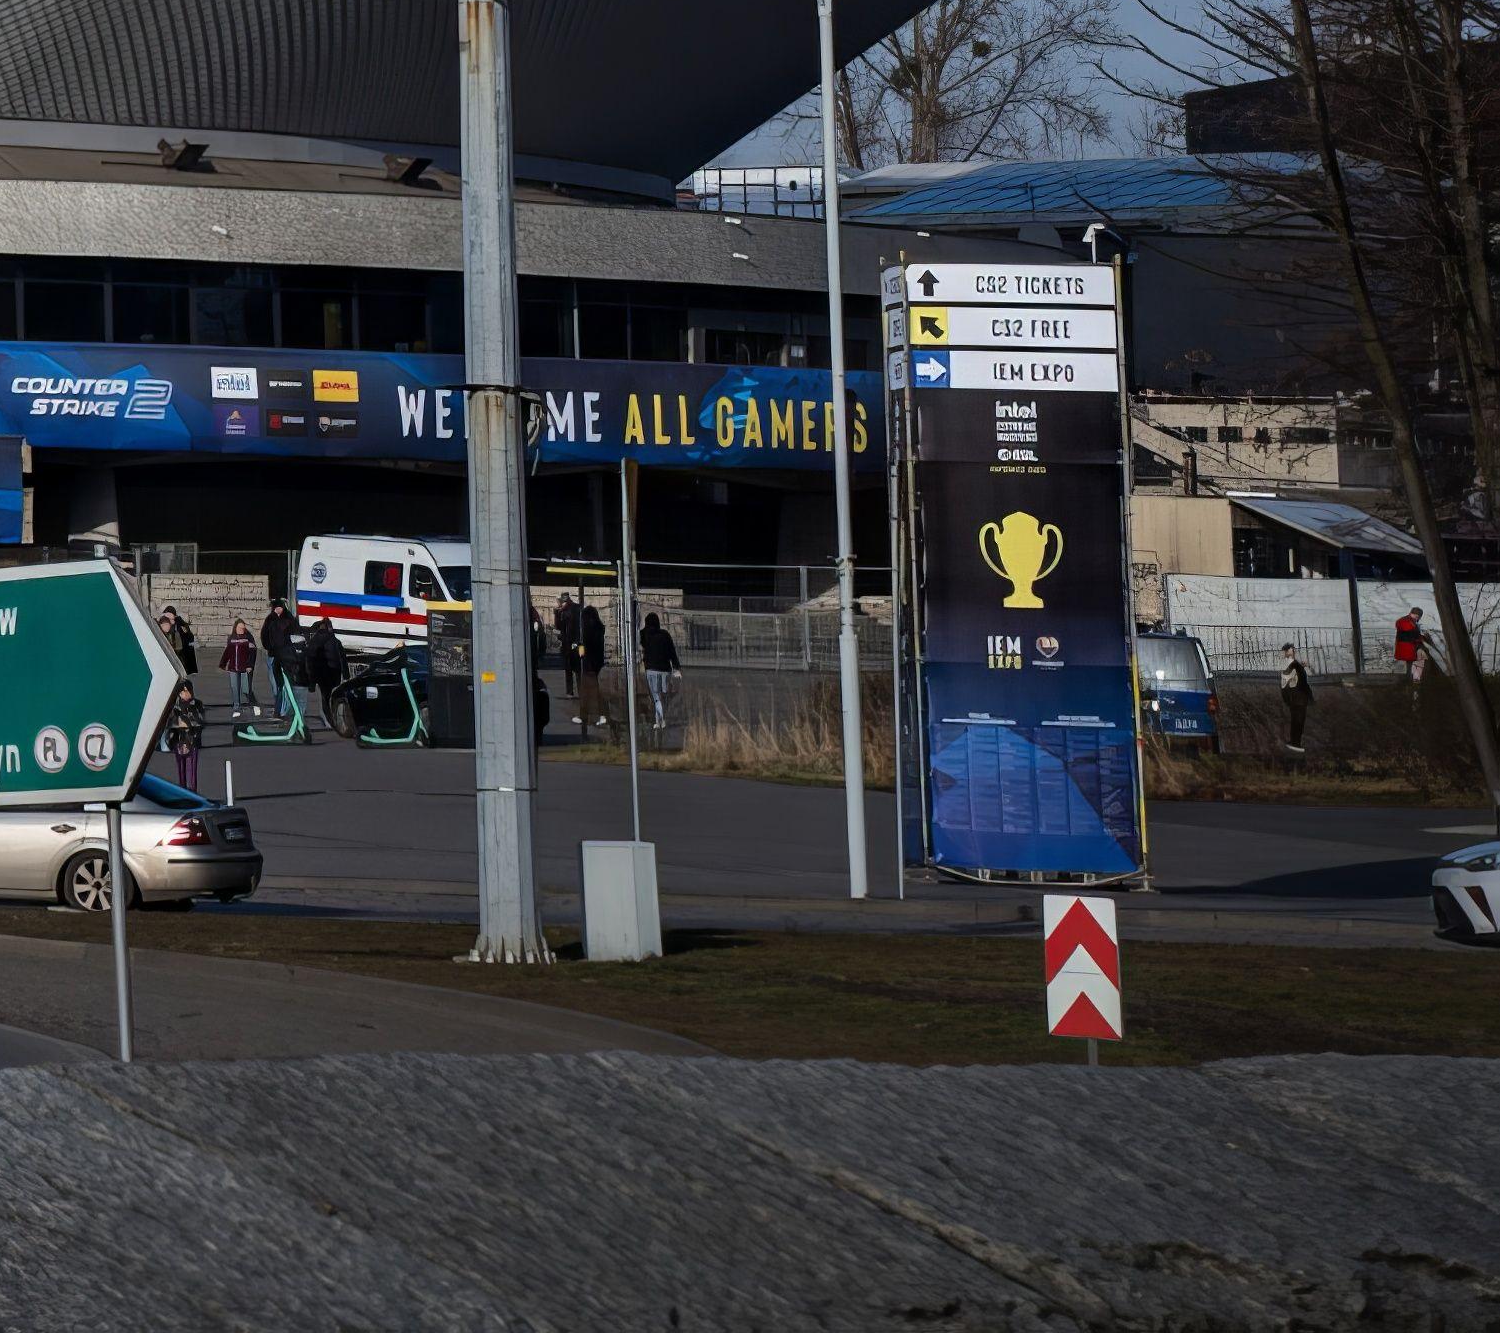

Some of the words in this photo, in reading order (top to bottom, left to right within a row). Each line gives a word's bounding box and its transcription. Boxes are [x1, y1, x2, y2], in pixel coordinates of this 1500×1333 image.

[975, 275, 1008, 294] CS2
[1014, 276, 1085, 295] TICKETS
[993, 362, 1024, 381] IEM
[1031, 363, 1075, 382] EXPO
[11, 377, 129, 395] COUNTER
[29, 398, 120, 417] STRIKE
[624, 393, 696, 446] ALL
